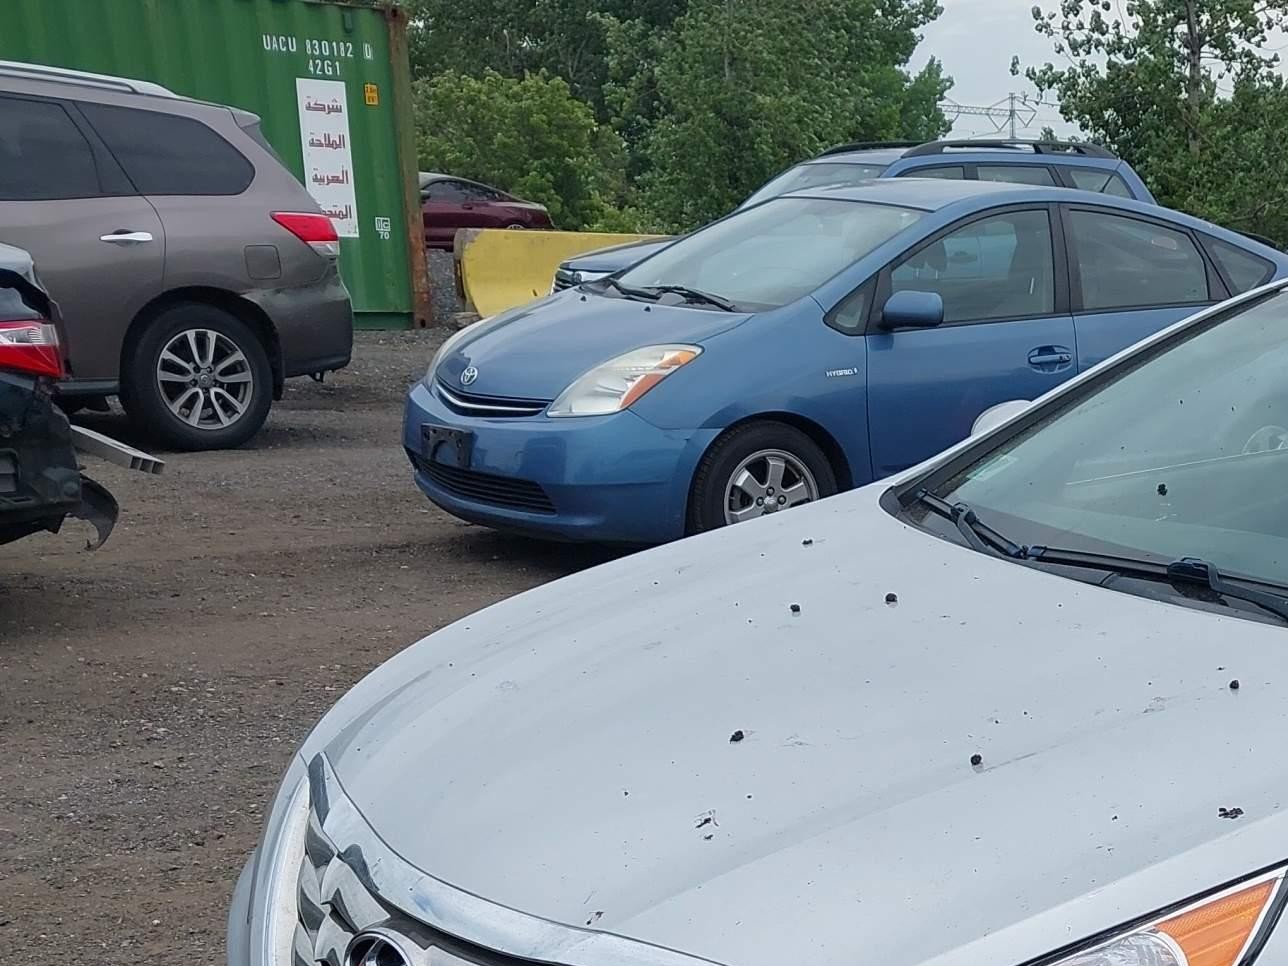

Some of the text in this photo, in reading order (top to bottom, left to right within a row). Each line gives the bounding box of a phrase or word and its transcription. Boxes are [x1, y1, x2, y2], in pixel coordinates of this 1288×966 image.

[262, 34, 297, 52] UACU
[305, 39, 353, 58] 830182
[308, 59, 340, 76] 42G1
[305, 96, 343, 115] شركة
[308, 131, 346, 150] الملاحة
[312, 167, 349, 186] العربية
[379, 231, 390, 240] 70
